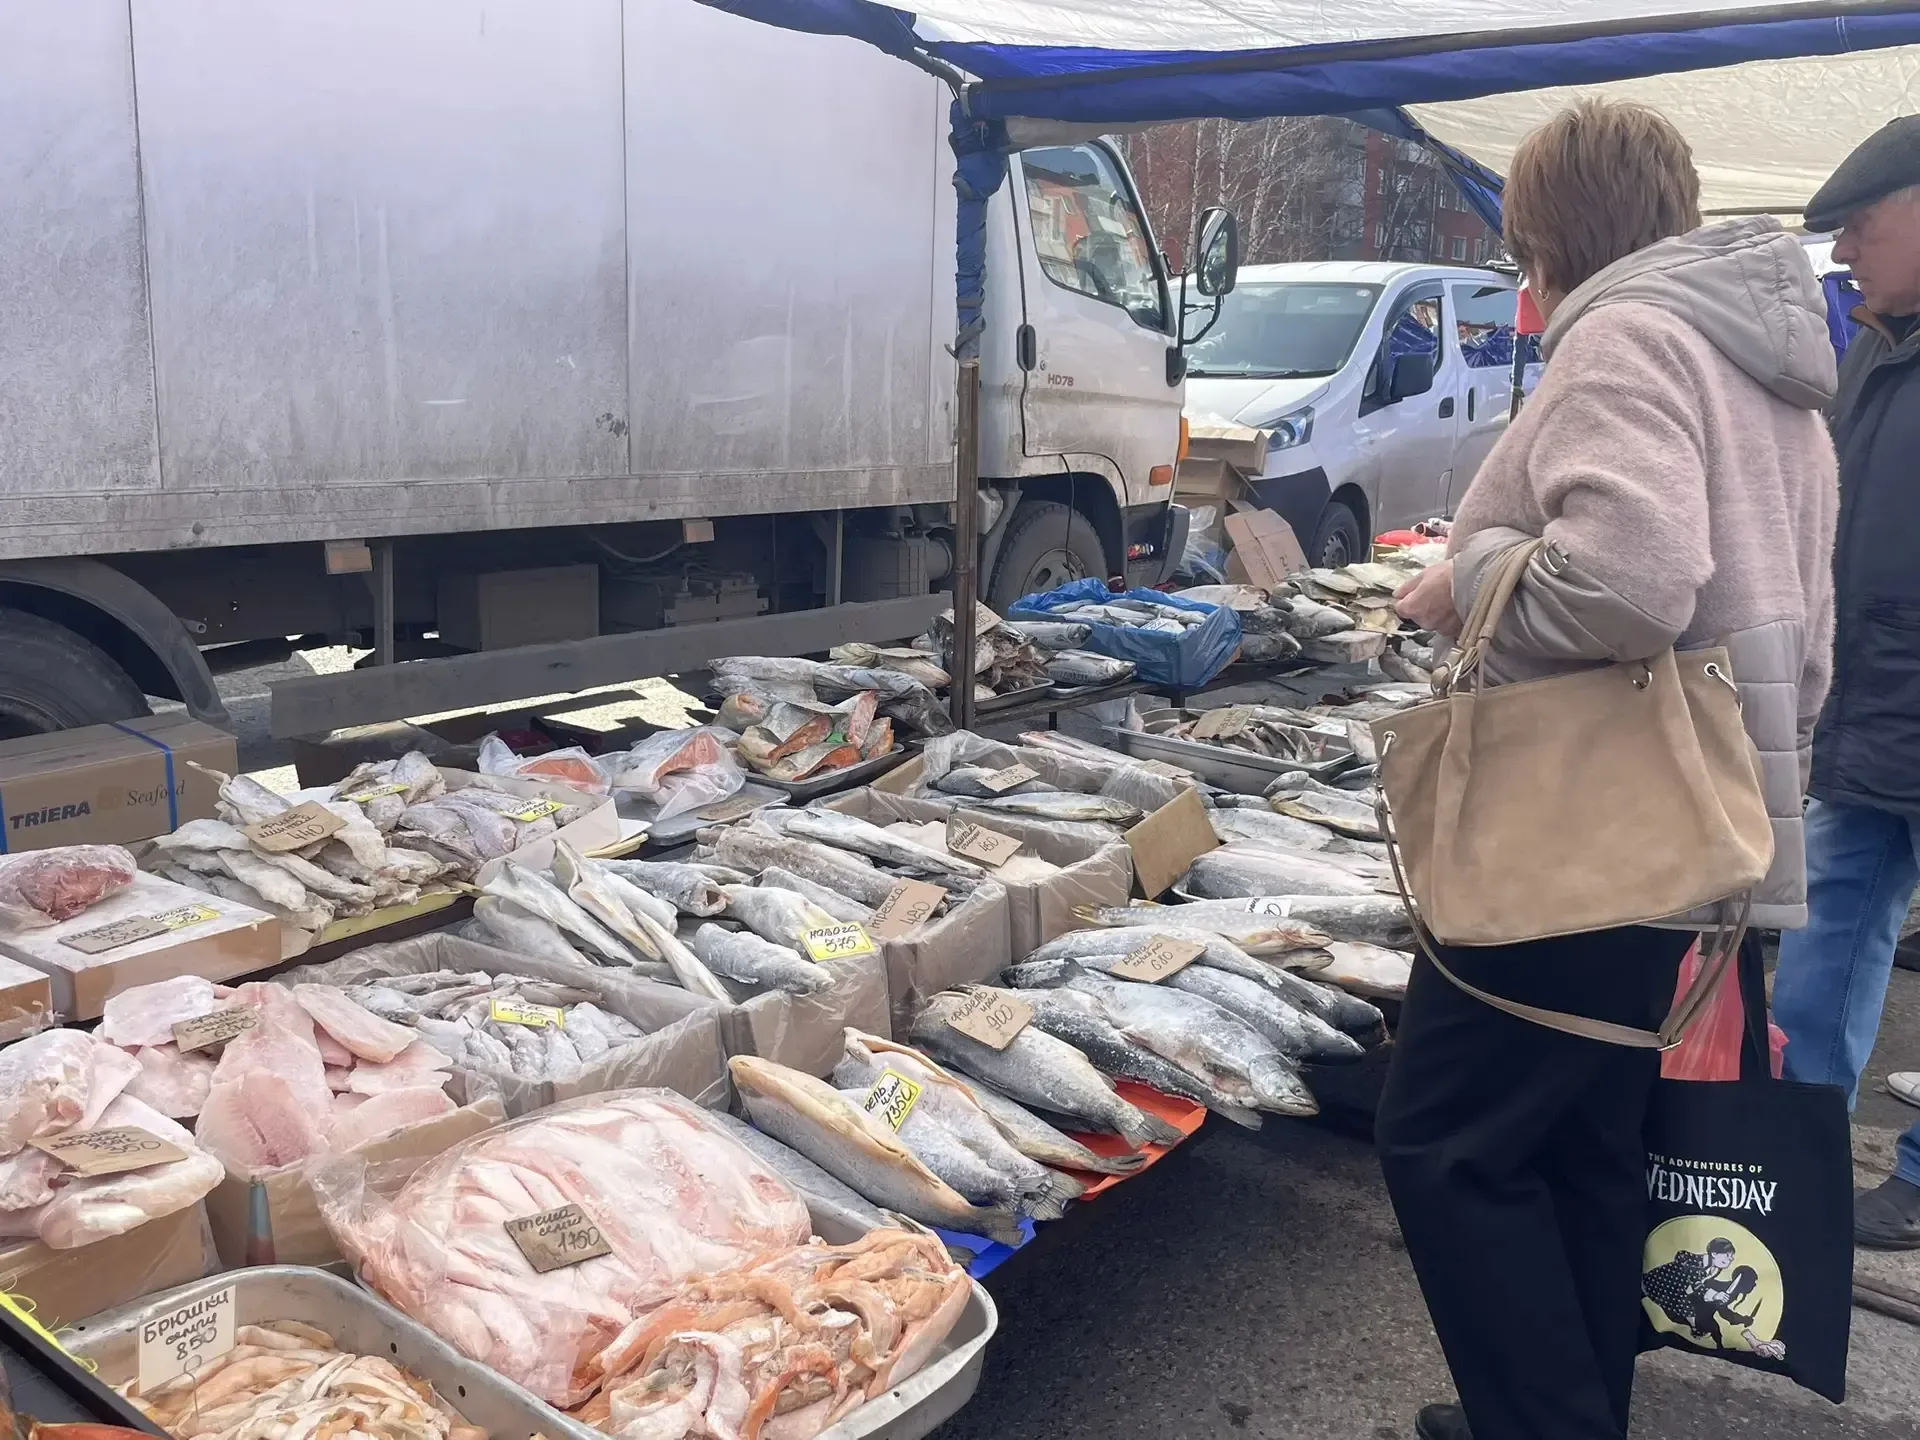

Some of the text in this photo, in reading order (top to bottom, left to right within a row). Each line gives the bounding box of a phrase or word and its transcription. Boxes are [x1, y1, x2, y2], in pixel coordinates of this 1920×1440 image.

[1047, 373, 1074, 387] HD78
[127, 780, 185, 806] Seafod
[287, 823, 325, 841] 440
[868, 886, 908, 929] треска
[985, 1003, 1014, 1031] 900
[864, 1086, 886, 1113] рель
[885, 1086, 914, 1129] 1350
[106, 1140, 161, 1154] 350
[1648, 1152, 1763, 1174] THE ADVENTURES OF
[558, 1226, 600, 1253] 1750
[143, 1290, 229, 1344] БРЮШКИ
[176, 1327, 217, 1360] 850
